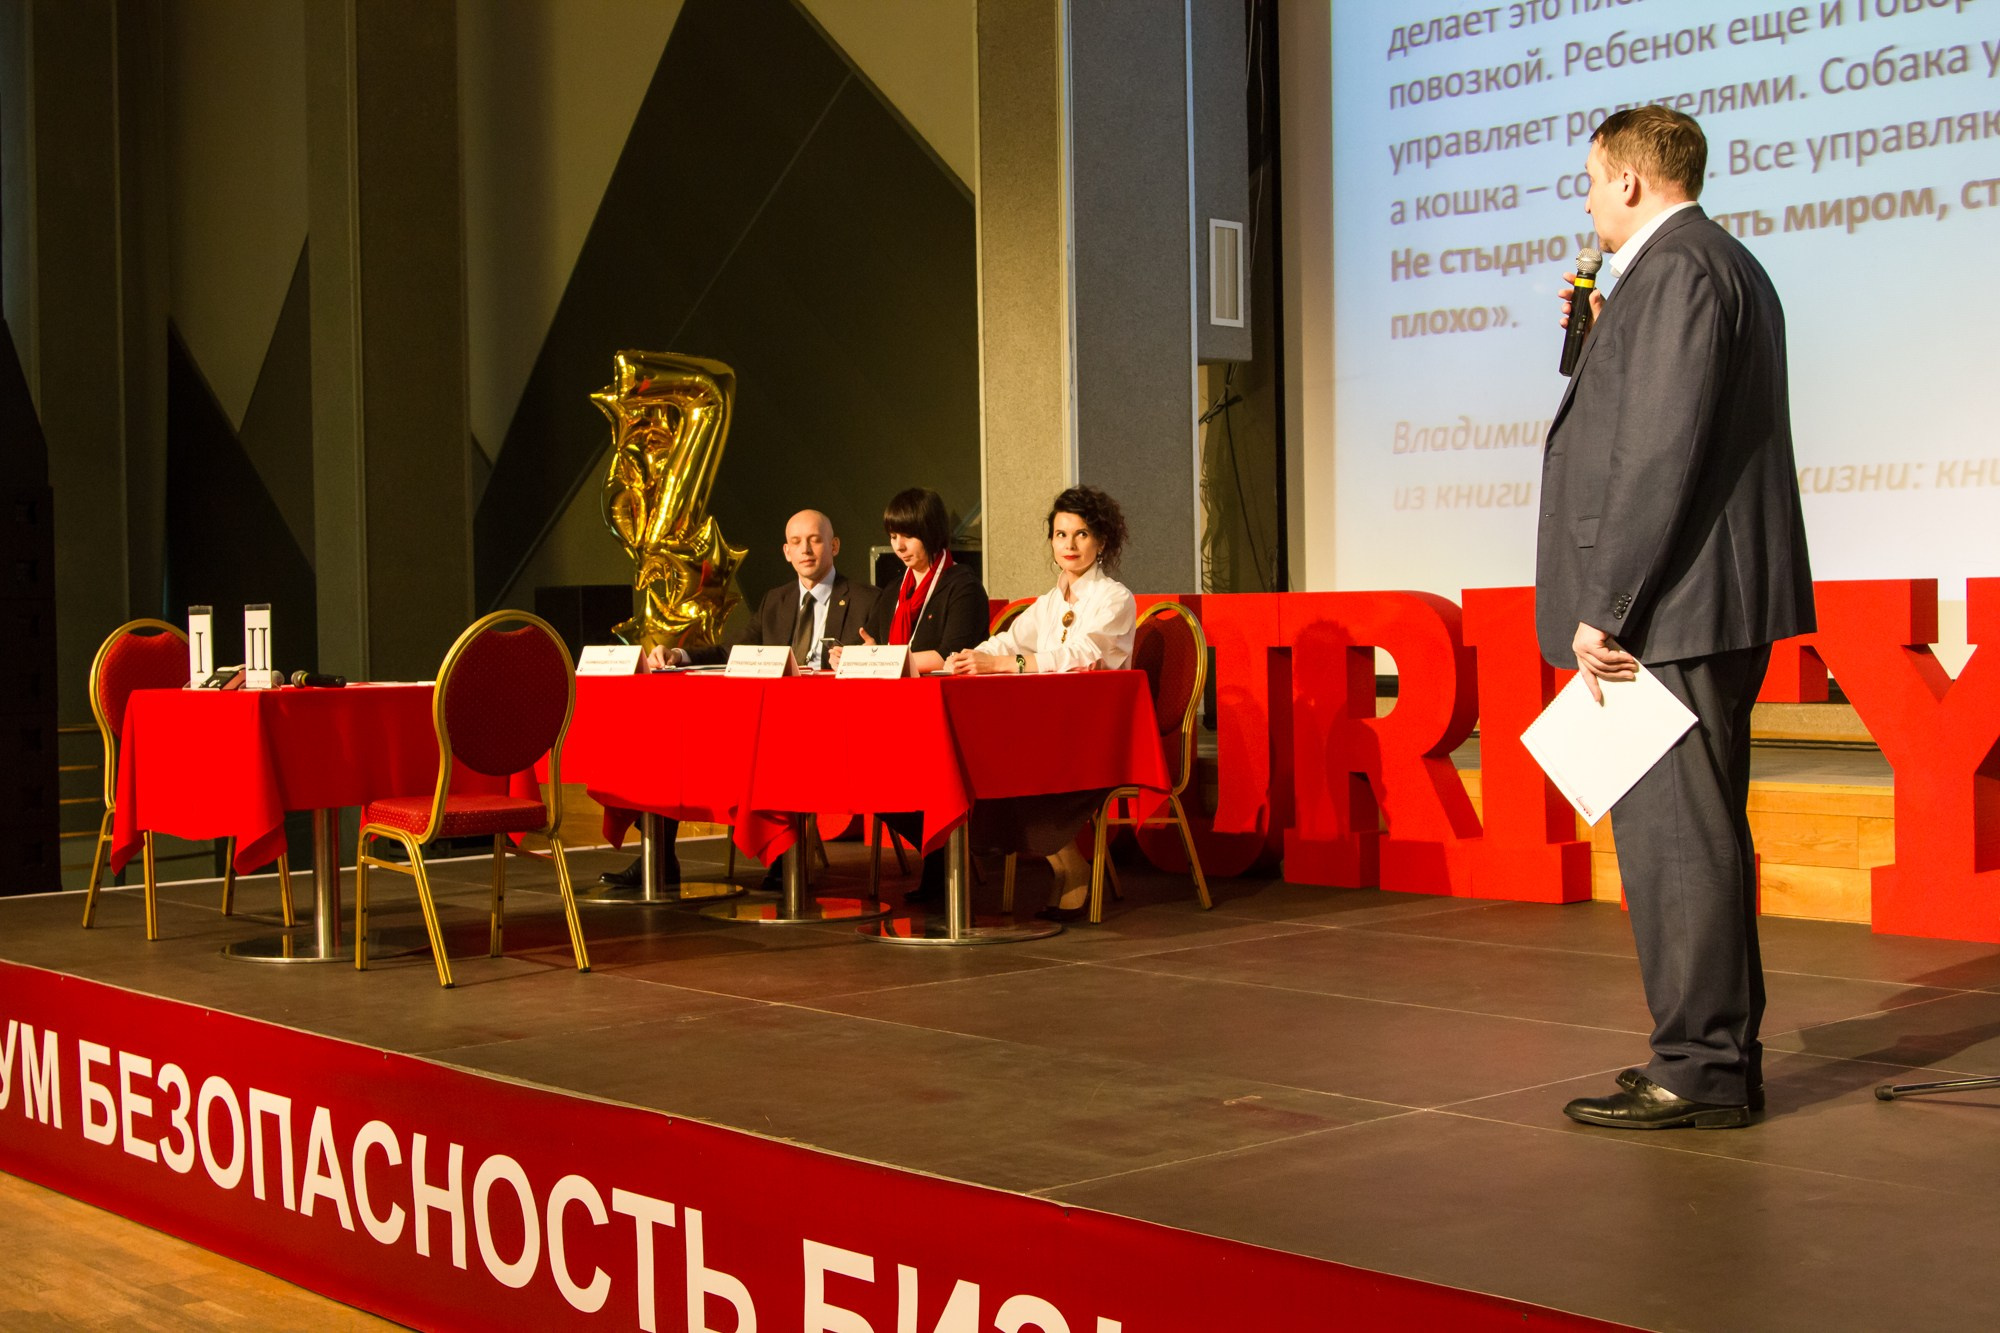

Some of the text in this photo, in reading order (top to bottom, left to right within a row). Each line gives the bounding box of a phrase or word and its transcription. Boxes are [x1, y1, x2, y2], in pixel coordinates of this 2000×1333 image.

[1387, 0, 1561, 61] делает это
[1389, 48, 1553, 111] повозкой.
[1564, 23, 1717, 77] Ребенок
[1727, 6, 1810, 45] еще
[1820, 0, 1843, 29] и
[1389, 115, 1559, 175] управляет
[1820, 44, 1969, 95] Собака
[1390, 200, 1406, 225] а
[1415, 184, 1519, 221] кошка
[1729, 138, 1795, 176] Все
[1391, 247, 1430, 282] Не
[1439, 233, 1566, 277] стыдно
[1784, 186, 1948, 235] миром,
[1391, 305, 1519, 340] плохо».
[1393, 484, 1427, 511] из
[1434, 481, 1532, 510] книги
[79, 1038, 757, 1333] БЕЗОПАСНОСТЬ
